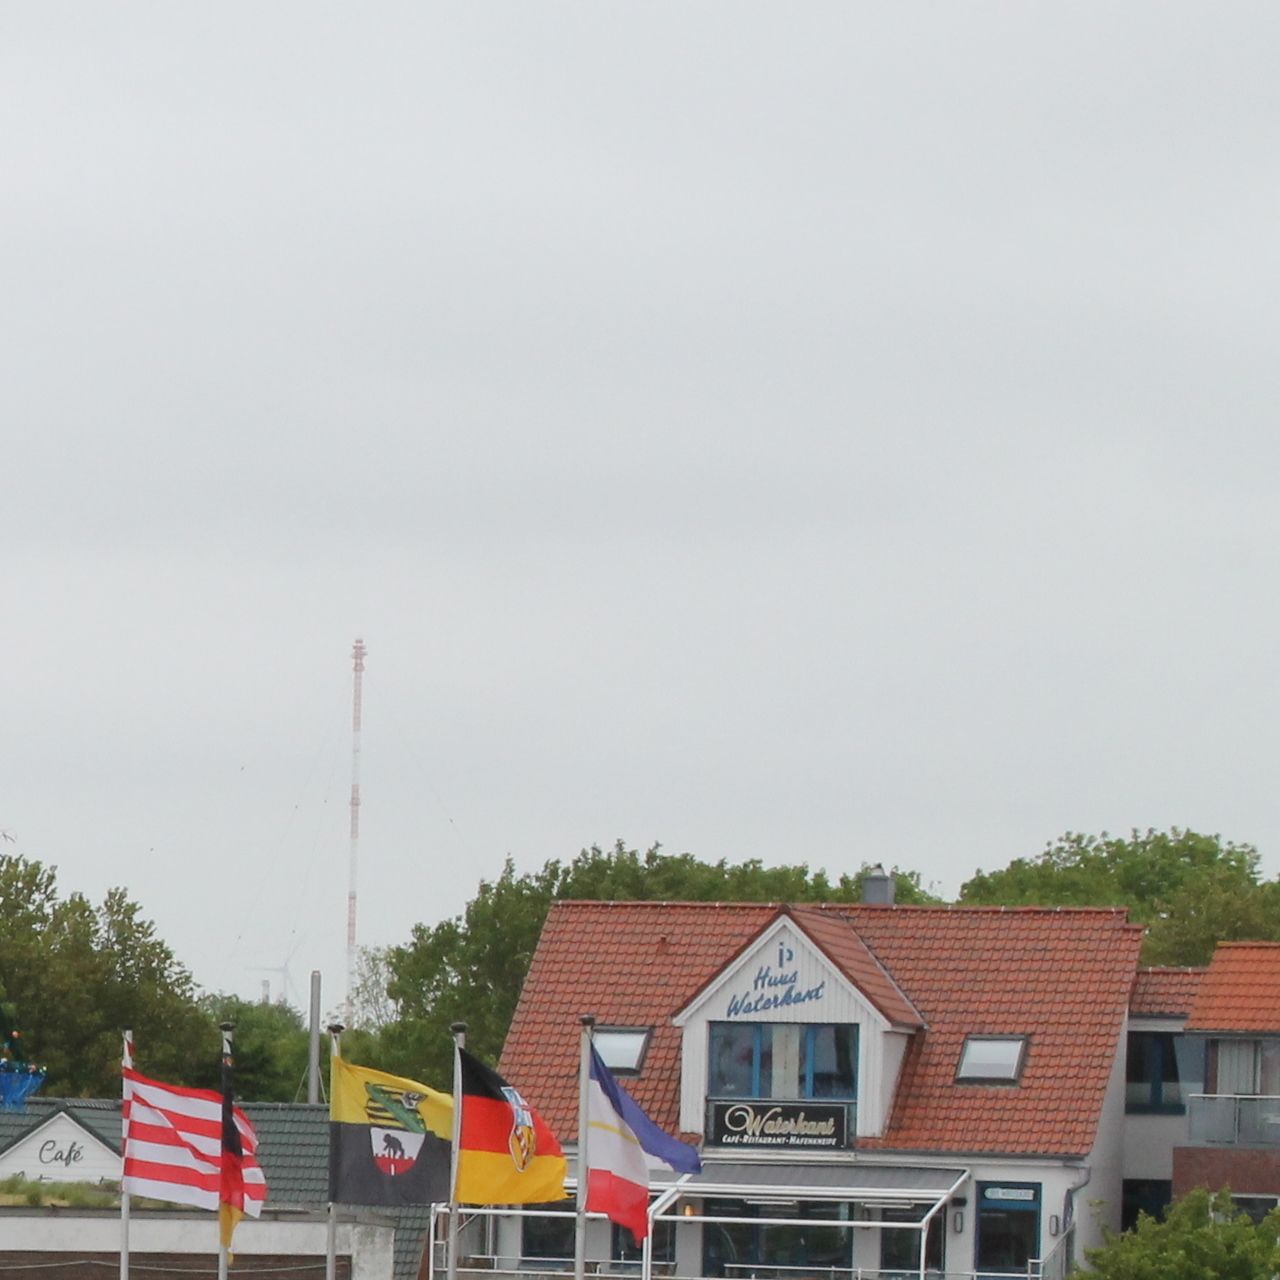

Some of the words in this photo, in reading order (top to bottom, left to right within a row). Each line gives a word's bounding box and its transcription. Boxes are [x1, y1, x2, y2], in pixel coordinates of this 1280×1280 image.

[753, 965, 798, 991] Huus
[726, 980, 825, 1018] Waterkant
[725, 1104, 835, 1136] Waterkant
[39, 1140, 84, 1167] Café
